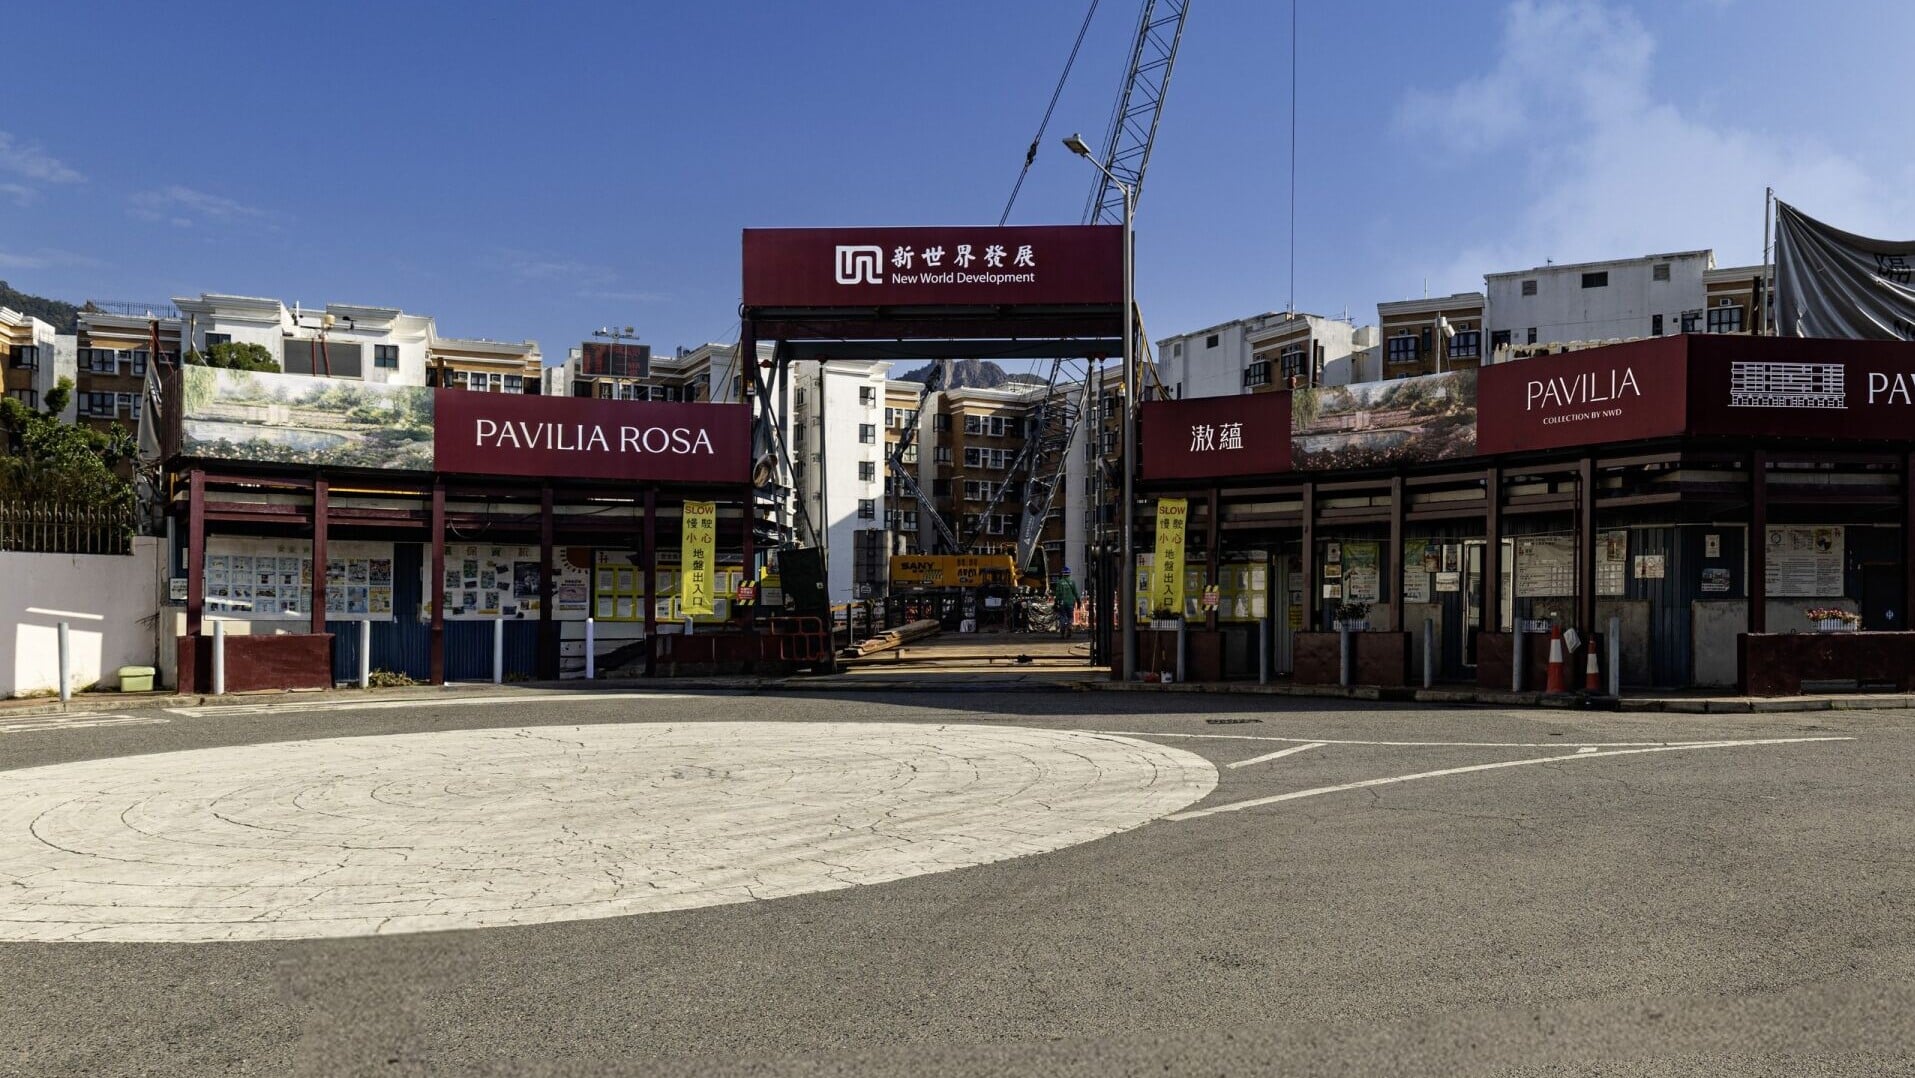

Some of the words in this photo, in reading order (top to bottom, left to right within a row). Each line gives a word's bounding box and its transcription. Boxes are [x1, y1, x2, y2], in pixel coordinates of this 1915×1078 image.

[891, 245, 1036, 269] 新世界發展
[892, 273, 918, 284] New
[920, 272, 953, 284] World
[956, 272, 1035, 285] Development
[1527, 367, 1641, 411] PAVILIA
[1543, 412, 1590, 425] COLLECTION
[1591, 410, 1601, 420] BY
[1602, 408, 1622, 418] NWD
[476, 419, 610, 452] PAVILIA
[620, 426, 714, 454] ROSA
[685, 505, 714, 515] SLOW
[1160, 506, 1185, 515] SLOW
[686, 533, 712, 544] 小心
[1159, 533, 1182, 545] 小心
[901, 562, 934, 570] SANY
[692, 548, 705, 606] 地盤出入口
[1163, 549, 1175, 606] 地盤出入口
